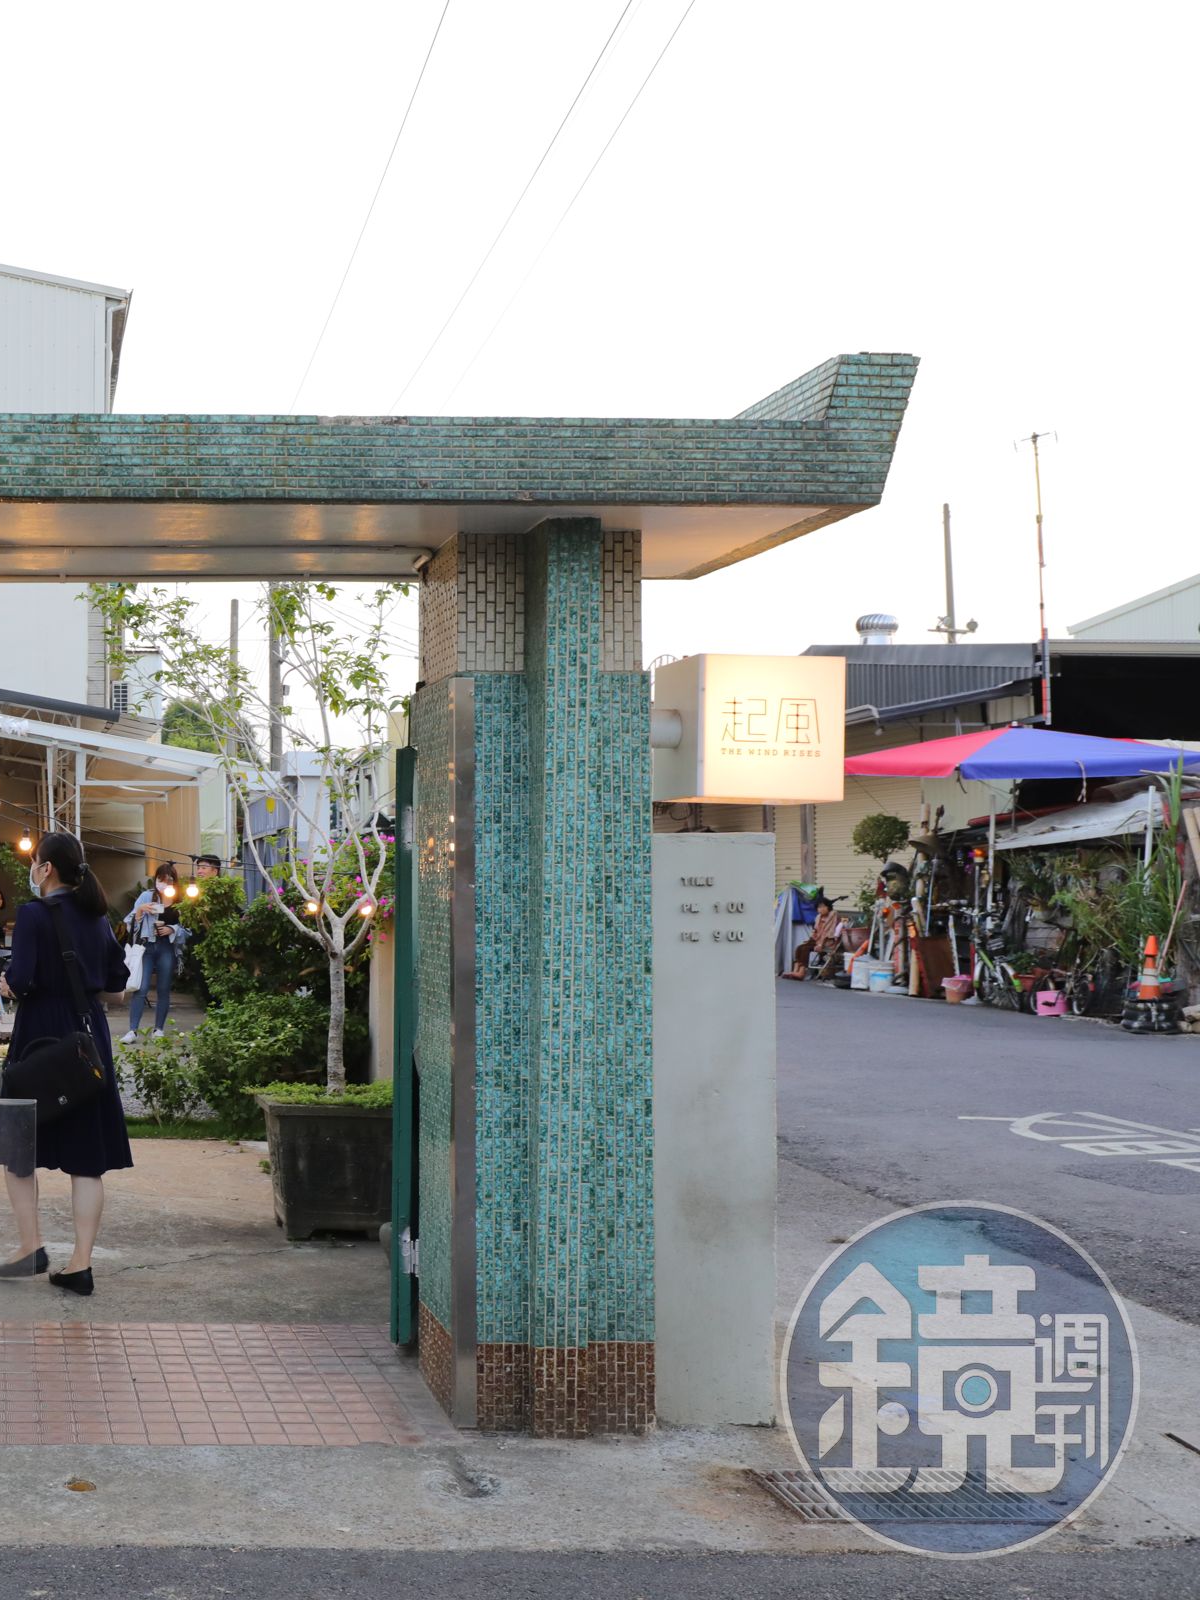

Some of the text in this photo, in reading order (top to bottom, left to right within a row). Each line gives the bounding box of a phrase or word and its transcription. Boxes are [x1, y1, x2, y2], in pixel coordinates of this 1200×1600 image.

[721, 696, 820, 744] 起風
[680, 876, 714, 887] TIME
[681, 903, 700, 913] PM
[681, 931, 700, 942] PM
